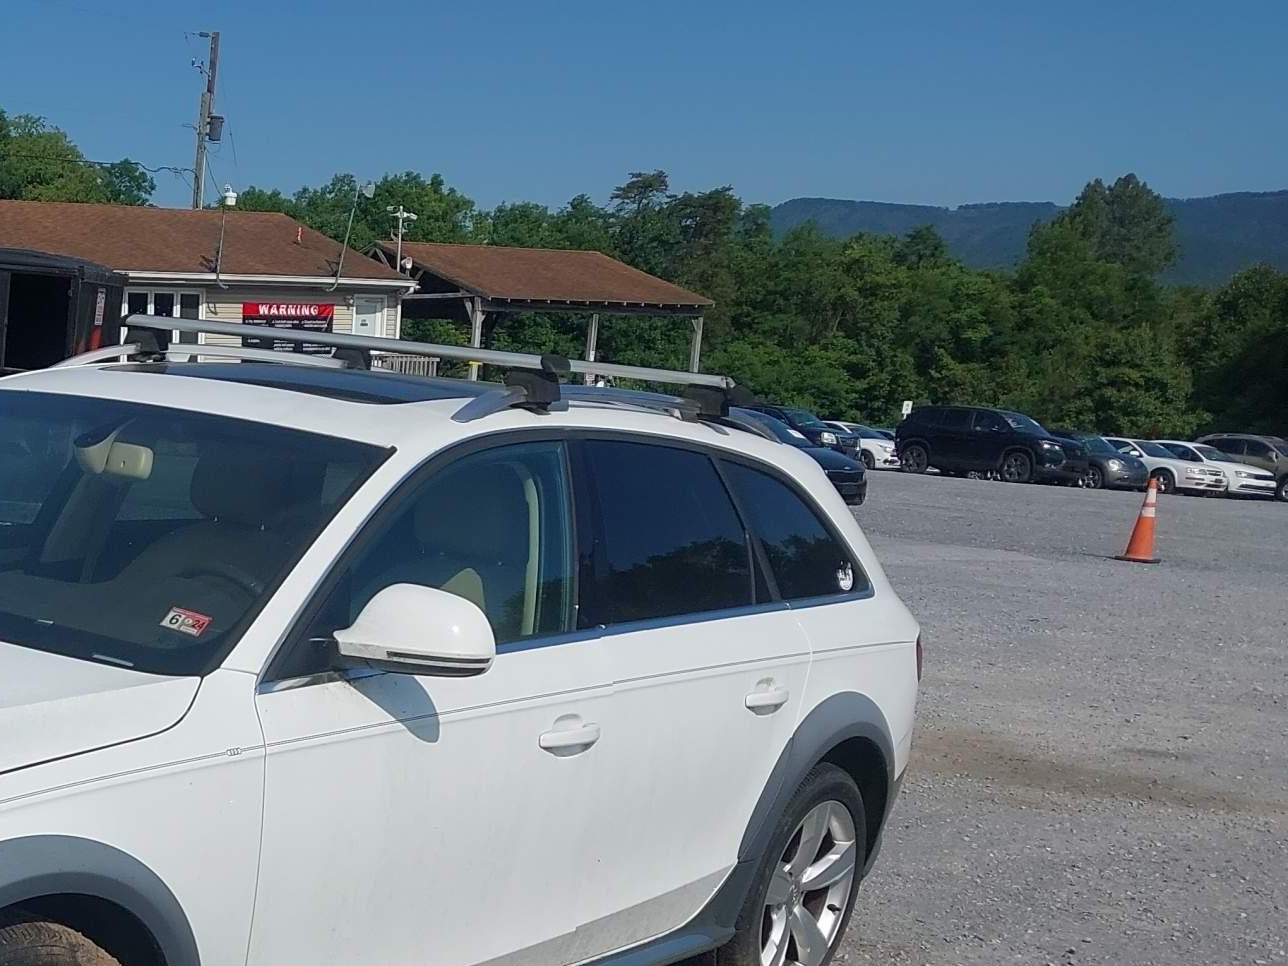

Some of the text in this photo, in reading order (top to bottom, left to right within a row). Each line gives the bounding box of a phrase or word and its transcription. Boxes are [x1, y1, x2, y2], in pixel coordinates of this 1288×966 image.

[258, 304, 319, 316] WARNING
[169, 614, 181, 625] 6
[193, 619, 205, 630] 24
